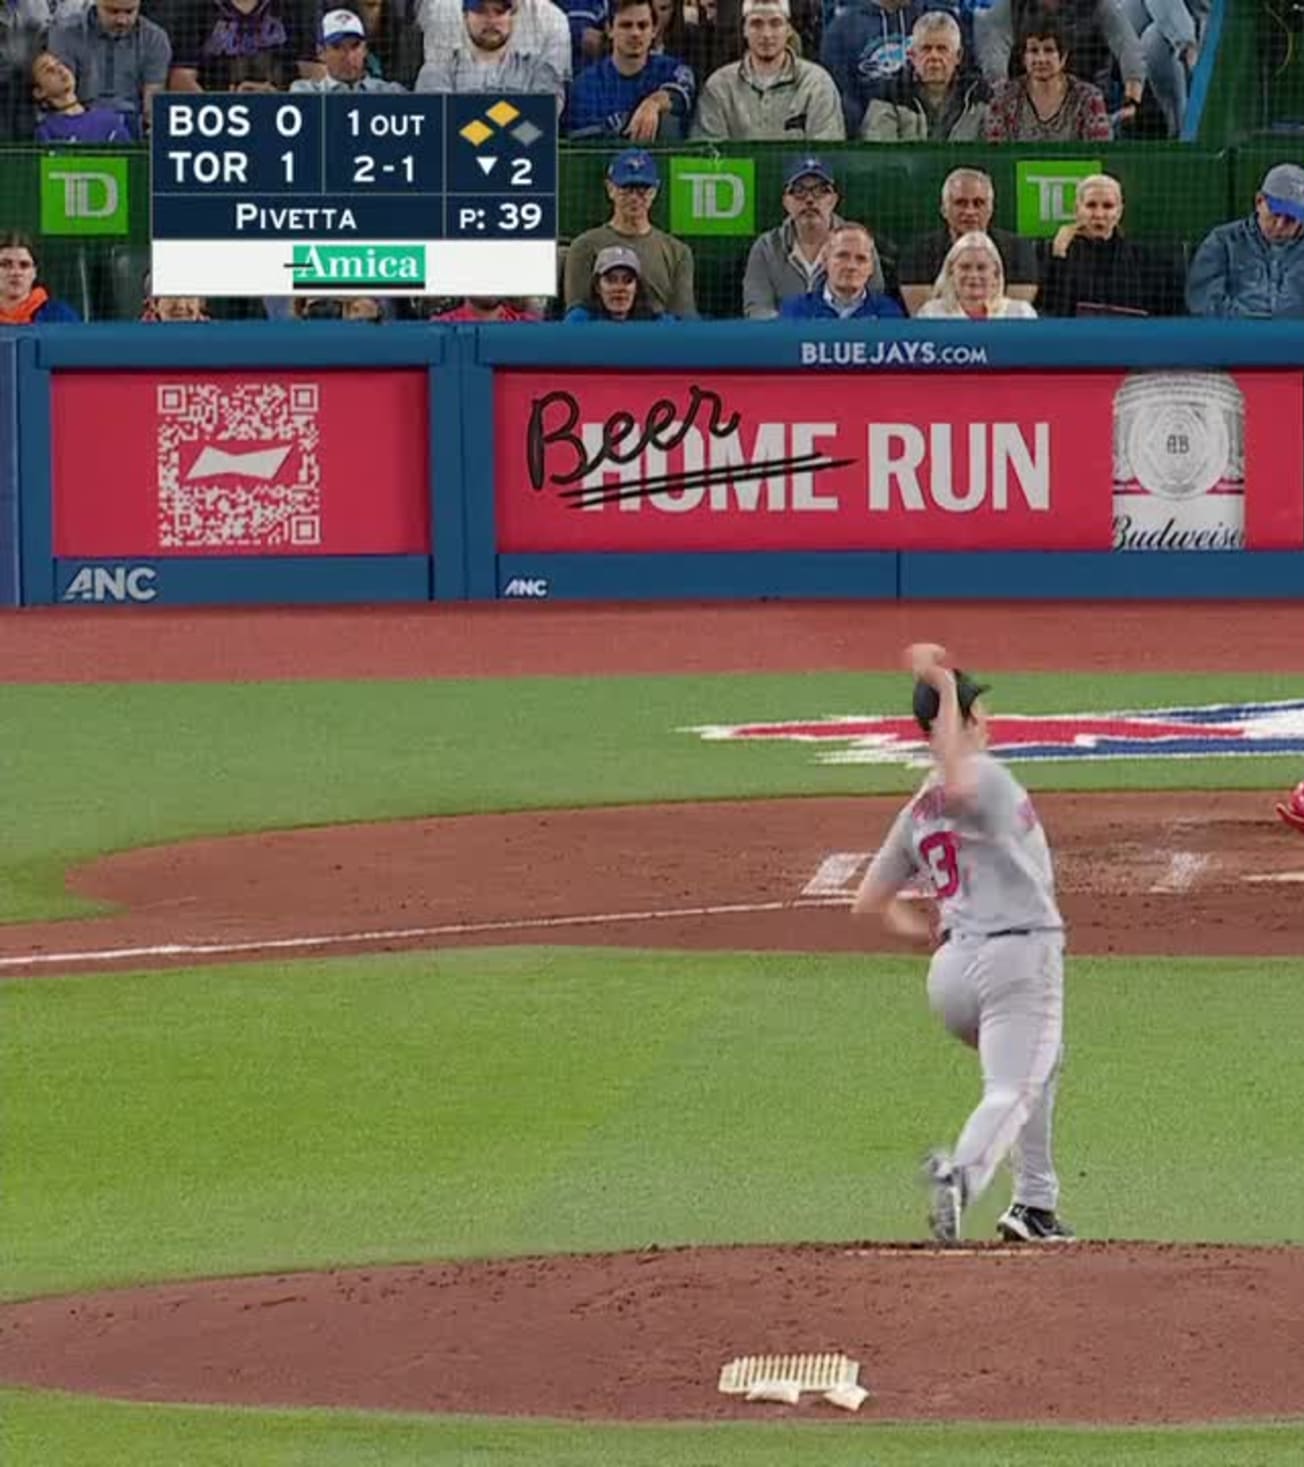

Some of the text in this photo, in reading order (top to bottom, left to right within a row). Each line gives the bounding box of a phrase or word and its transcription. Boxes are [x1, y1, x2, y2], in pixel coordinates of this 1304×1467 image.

[48, 171, 119, 217] TD
[678, 173, 746, 219] TD
[527, 385, 741, 490] Beer
[582, 423, 1050, 512] HOME RUN
[65, 567, 156, 600] ANC
[504, 579, 548, 596] ANC
